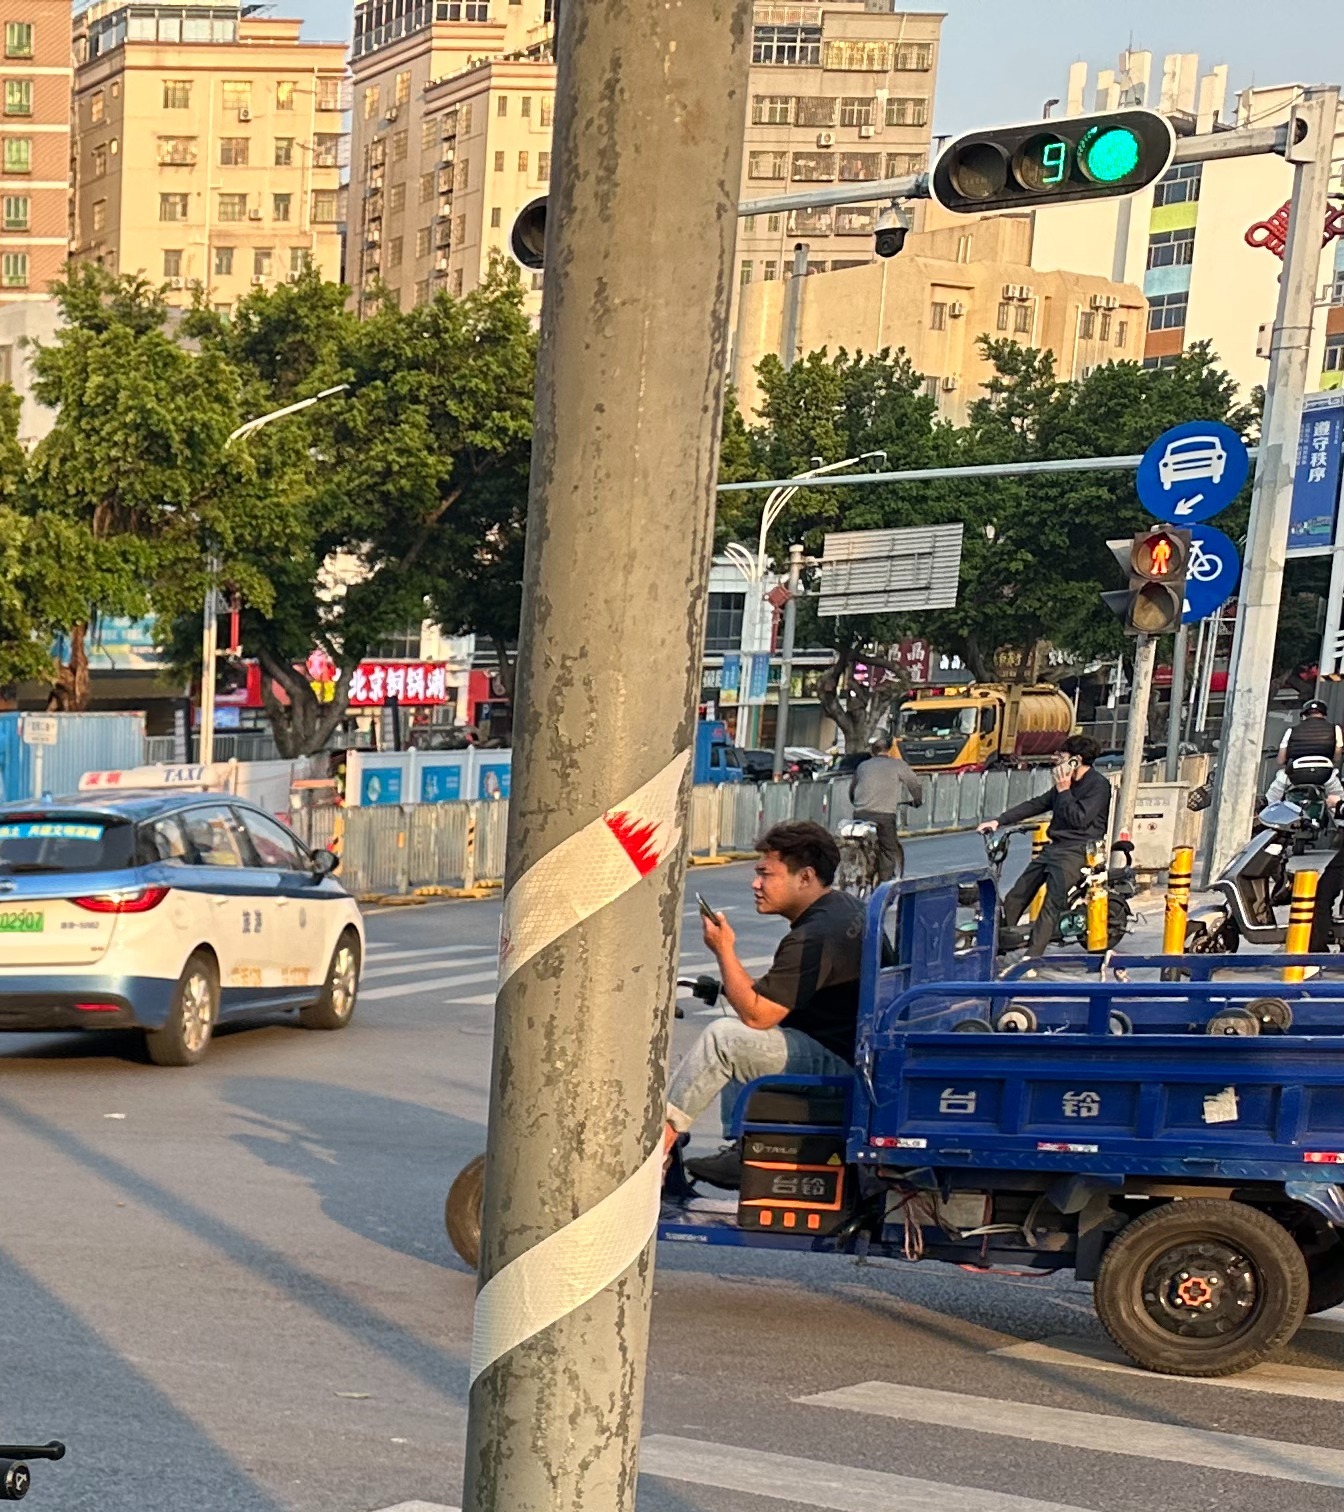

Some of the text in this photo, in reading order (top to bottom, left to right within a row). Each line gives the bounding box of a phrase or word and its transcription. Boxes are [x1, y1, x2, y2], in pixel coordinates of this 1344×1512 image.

[1043, 143, 1066, 183] 9
[1307, 420, 1331, 483] 遵守秩序
[163, 766, 205, 783] TAXI
